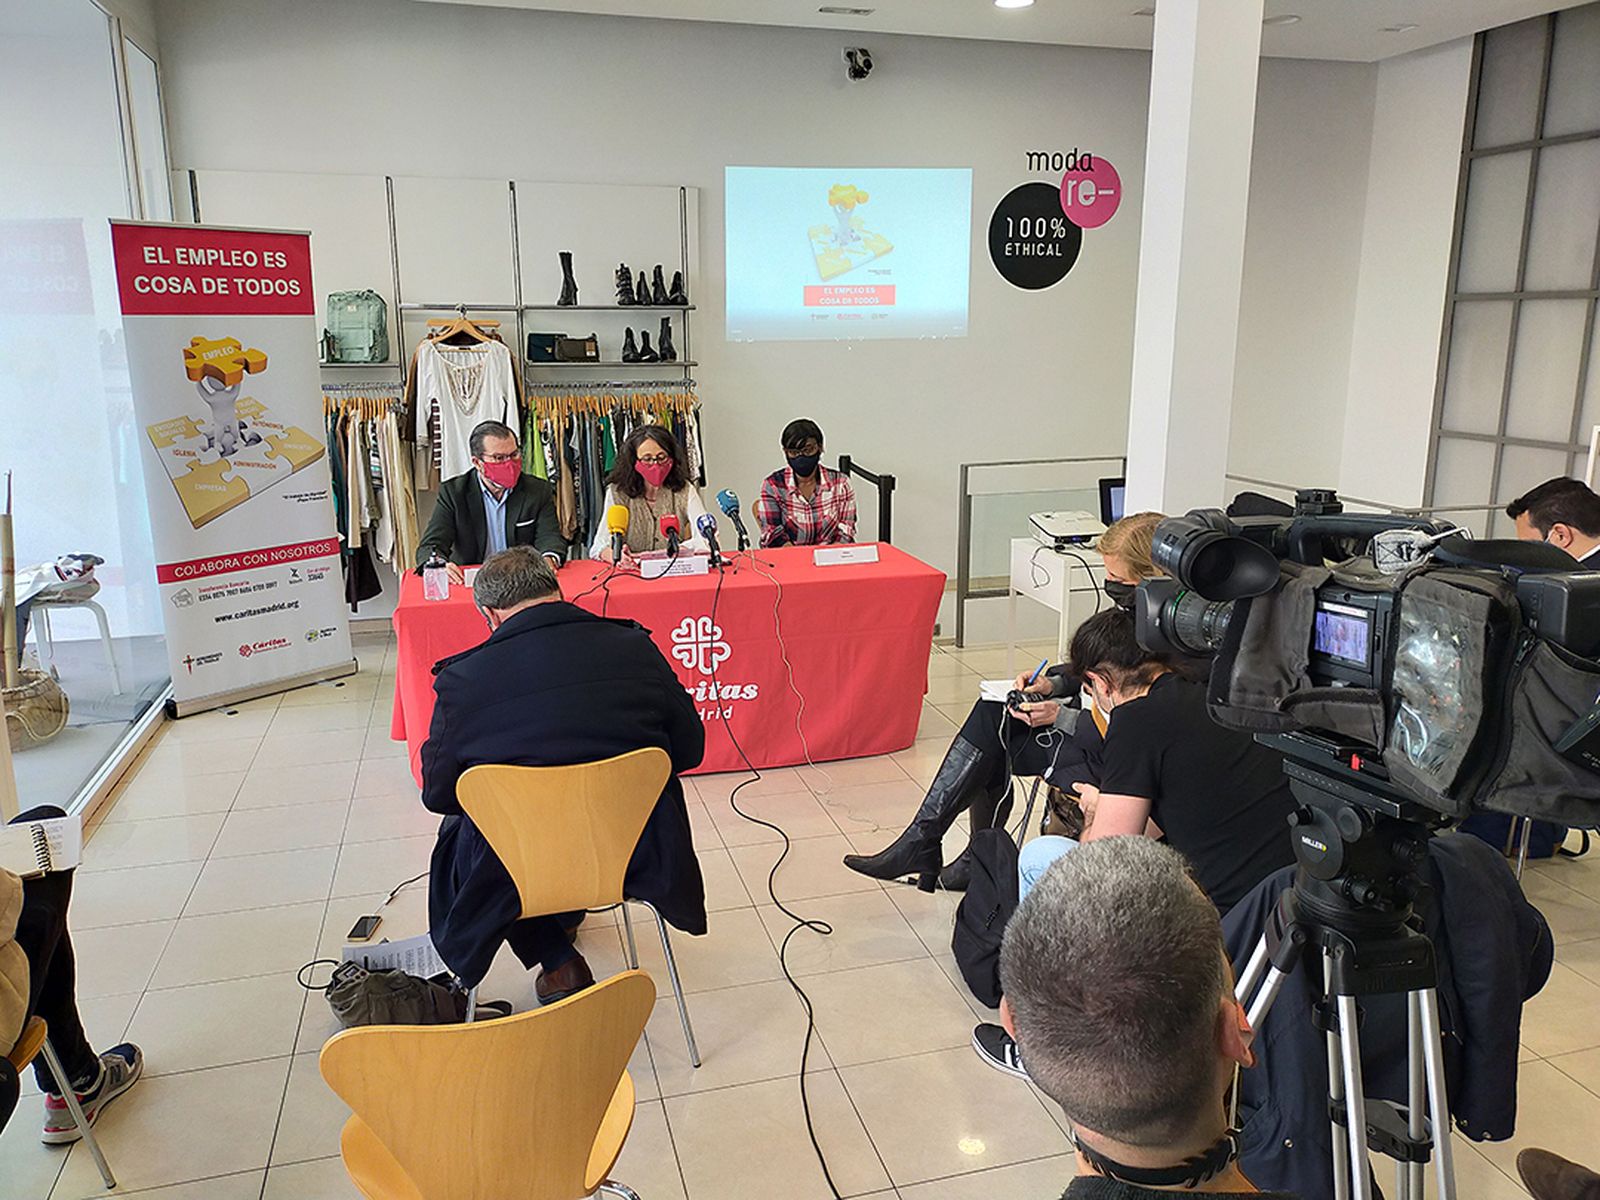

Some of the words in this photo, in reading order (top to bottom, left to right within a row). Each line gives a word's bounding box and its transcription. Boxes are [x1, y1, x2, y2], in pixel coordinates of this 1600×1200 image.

[1026, 147, 1094, 172] moda
[1006, 217, 1066, 239] 100%
[143, 246, 170, 264] EL
[176, 247, 258, 268] EMPLEO
[264, 251, 287, 268] ES
[1005, 243, 1062, 256] ETHICAL
[134, 275, 197, 294] COSA
[202, 277, 229, 294] DE
[233, 278, 301, 296] TODOS
[202, 345, 235, 361] EMPLEO
[172, 449, 197, 457] IGLESIA
[174, 561, 241, 578] COLABORA
[242, 554, 268, 566] CON
[270, 543, 332, 562] NOSOTROS
[215, 600, 299, 622] www.caritasmadrid.org
[698, 705, 733, 721] drid
